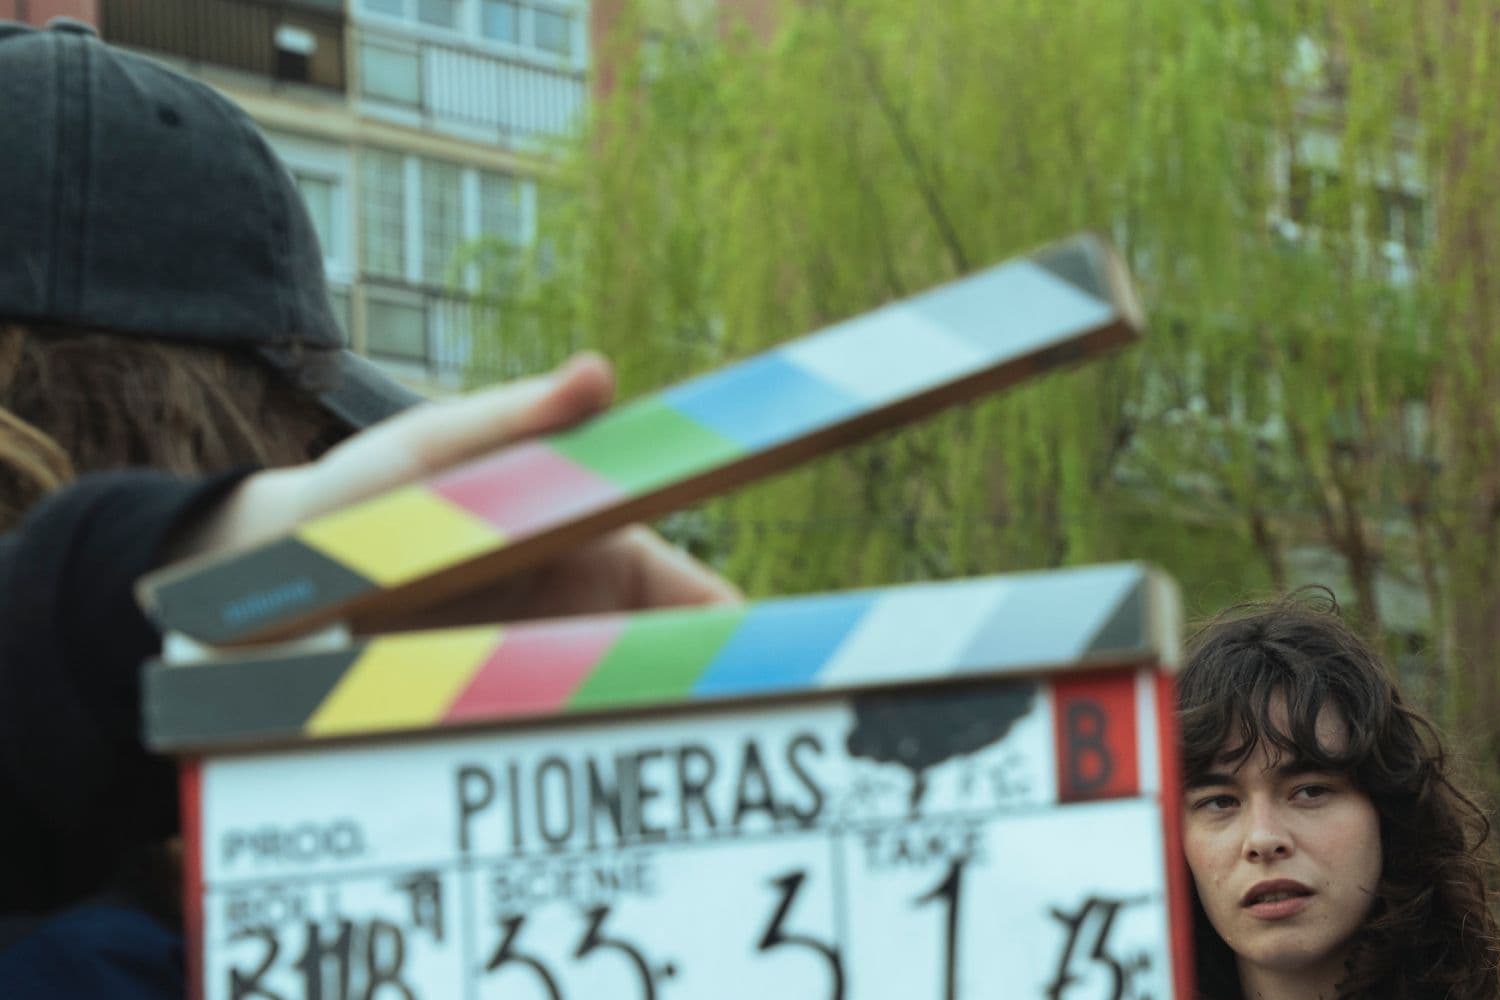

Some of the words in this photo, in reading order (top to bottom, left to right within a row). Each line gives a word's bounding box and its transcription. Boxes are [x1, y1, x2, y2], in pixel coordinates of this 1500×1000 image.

[1066, 700, 1114, 793] B
[454, 731, 826, 855] PIONERAS
[861, 824, 987, 867] TAKE
[492, 862, 660, 898] SCENE
